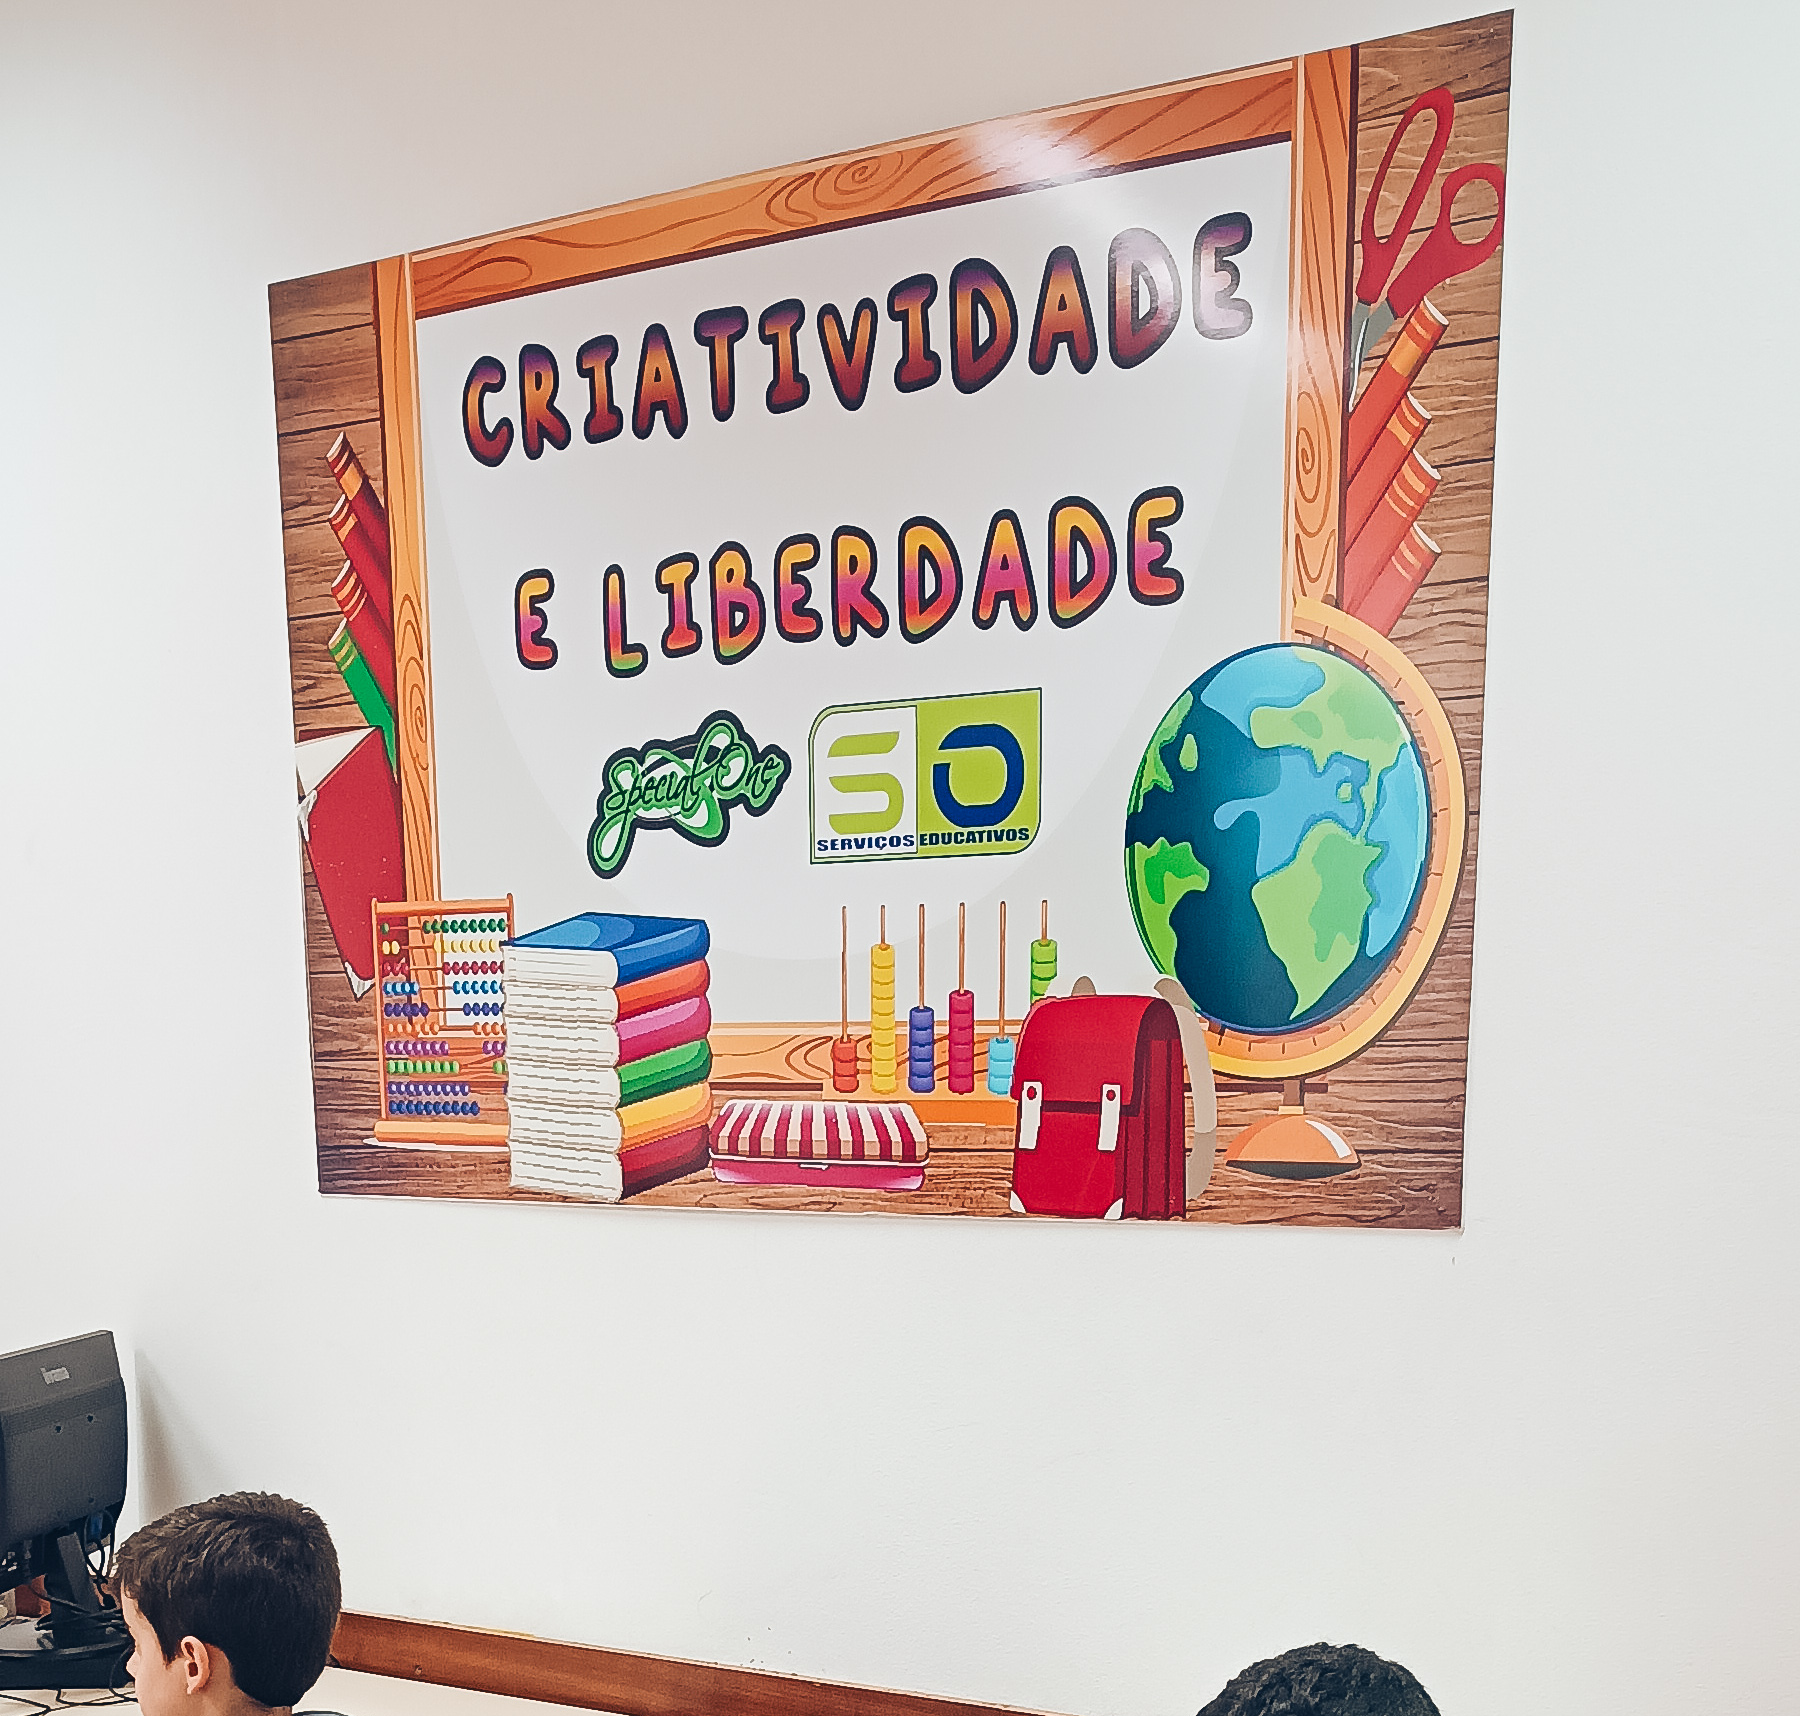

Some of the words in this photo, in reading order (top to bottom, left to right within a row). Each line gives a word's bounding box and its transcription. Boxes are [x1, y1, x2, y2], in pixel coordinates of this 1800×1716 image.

[462, 211, 1254, 467] CRIATIVIDADE
[515, 568, 556, 670] E
[603, 486, 1184, 678] LIBERDADE
[595, 720, 736, 868] Special
[714, 742, 784, 808] One
[816, 834, 915, 852] SERVIÇOS
[919, 827, 1030, 847] EDUCATIVOS
